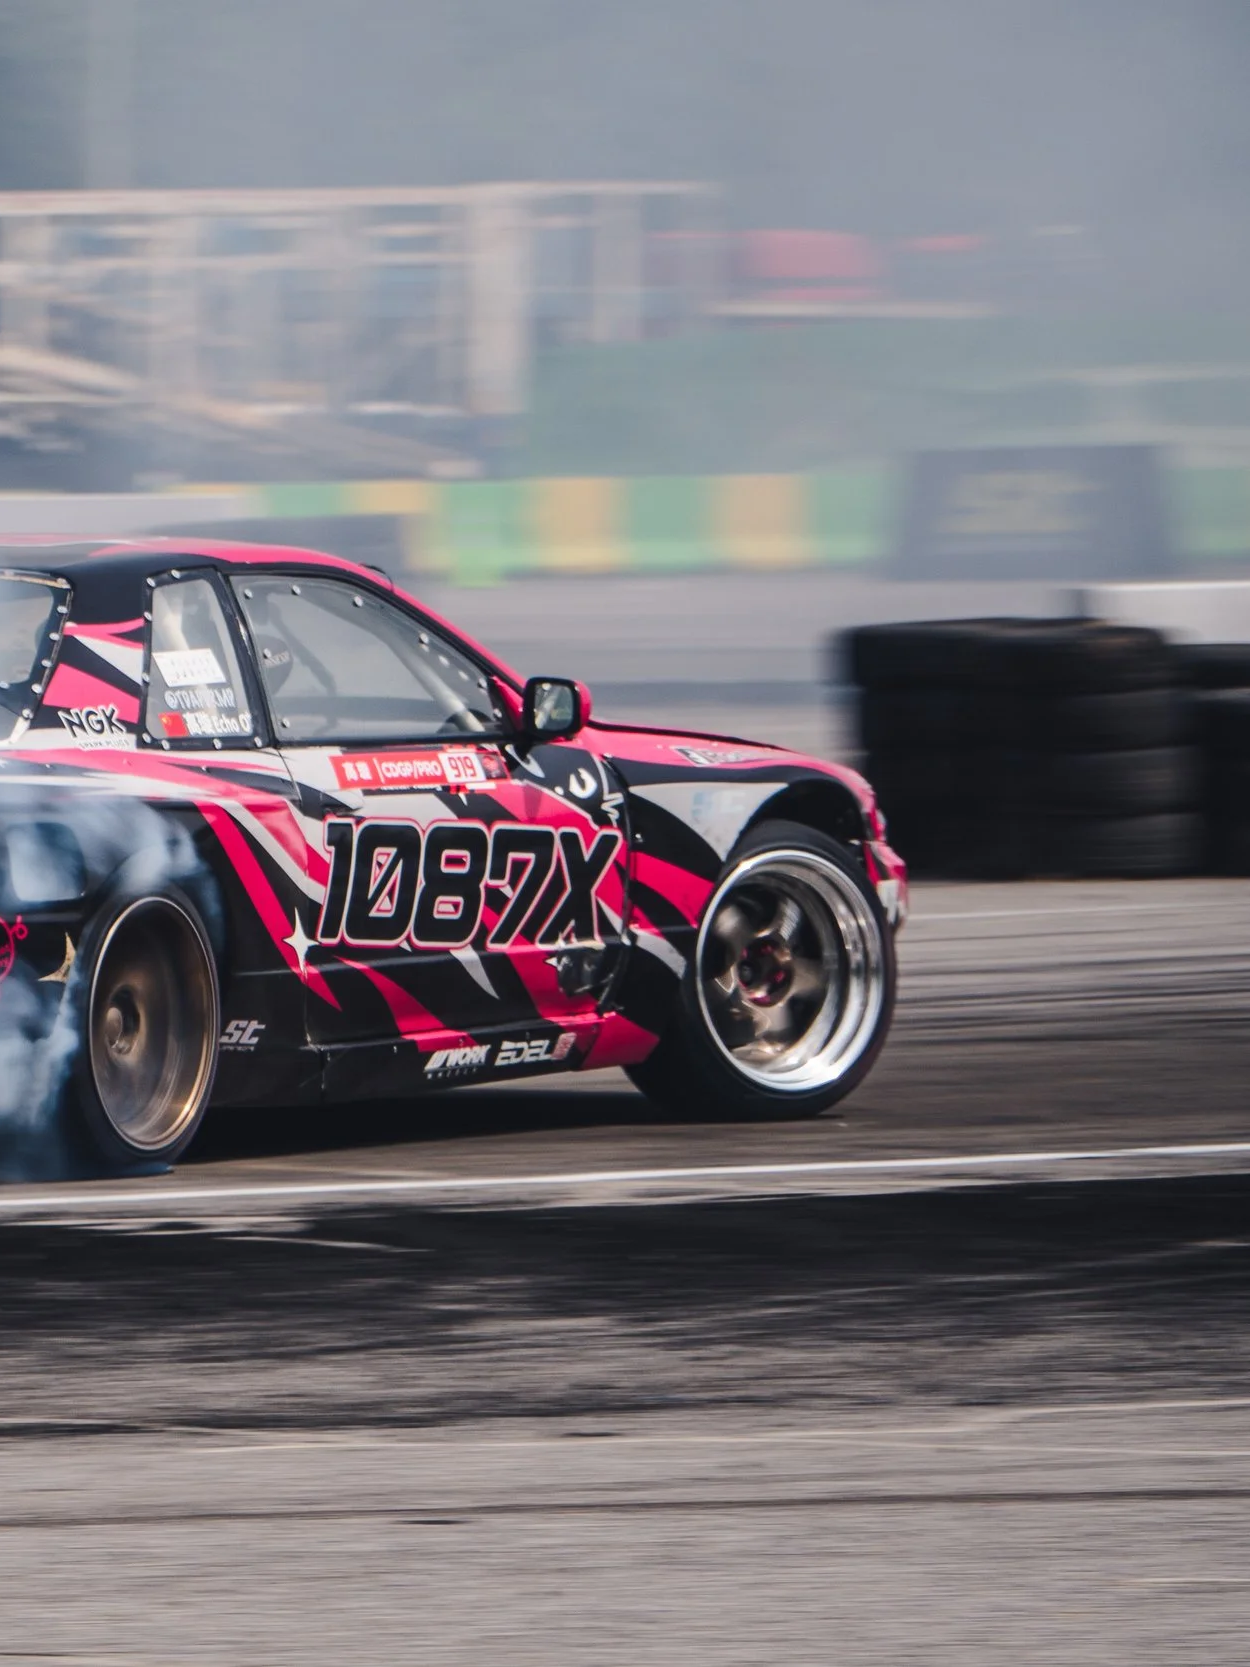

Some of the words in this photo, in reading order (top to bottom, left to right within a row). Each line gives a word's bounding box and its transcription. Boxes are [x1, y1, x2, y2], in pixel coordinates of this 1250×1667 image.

[58, 705, 126, 738] NGK
[211, 714, 240, 733] Echo
[448, 756, 477, 778] 919
[317, 817, 622, 950] 1087X
